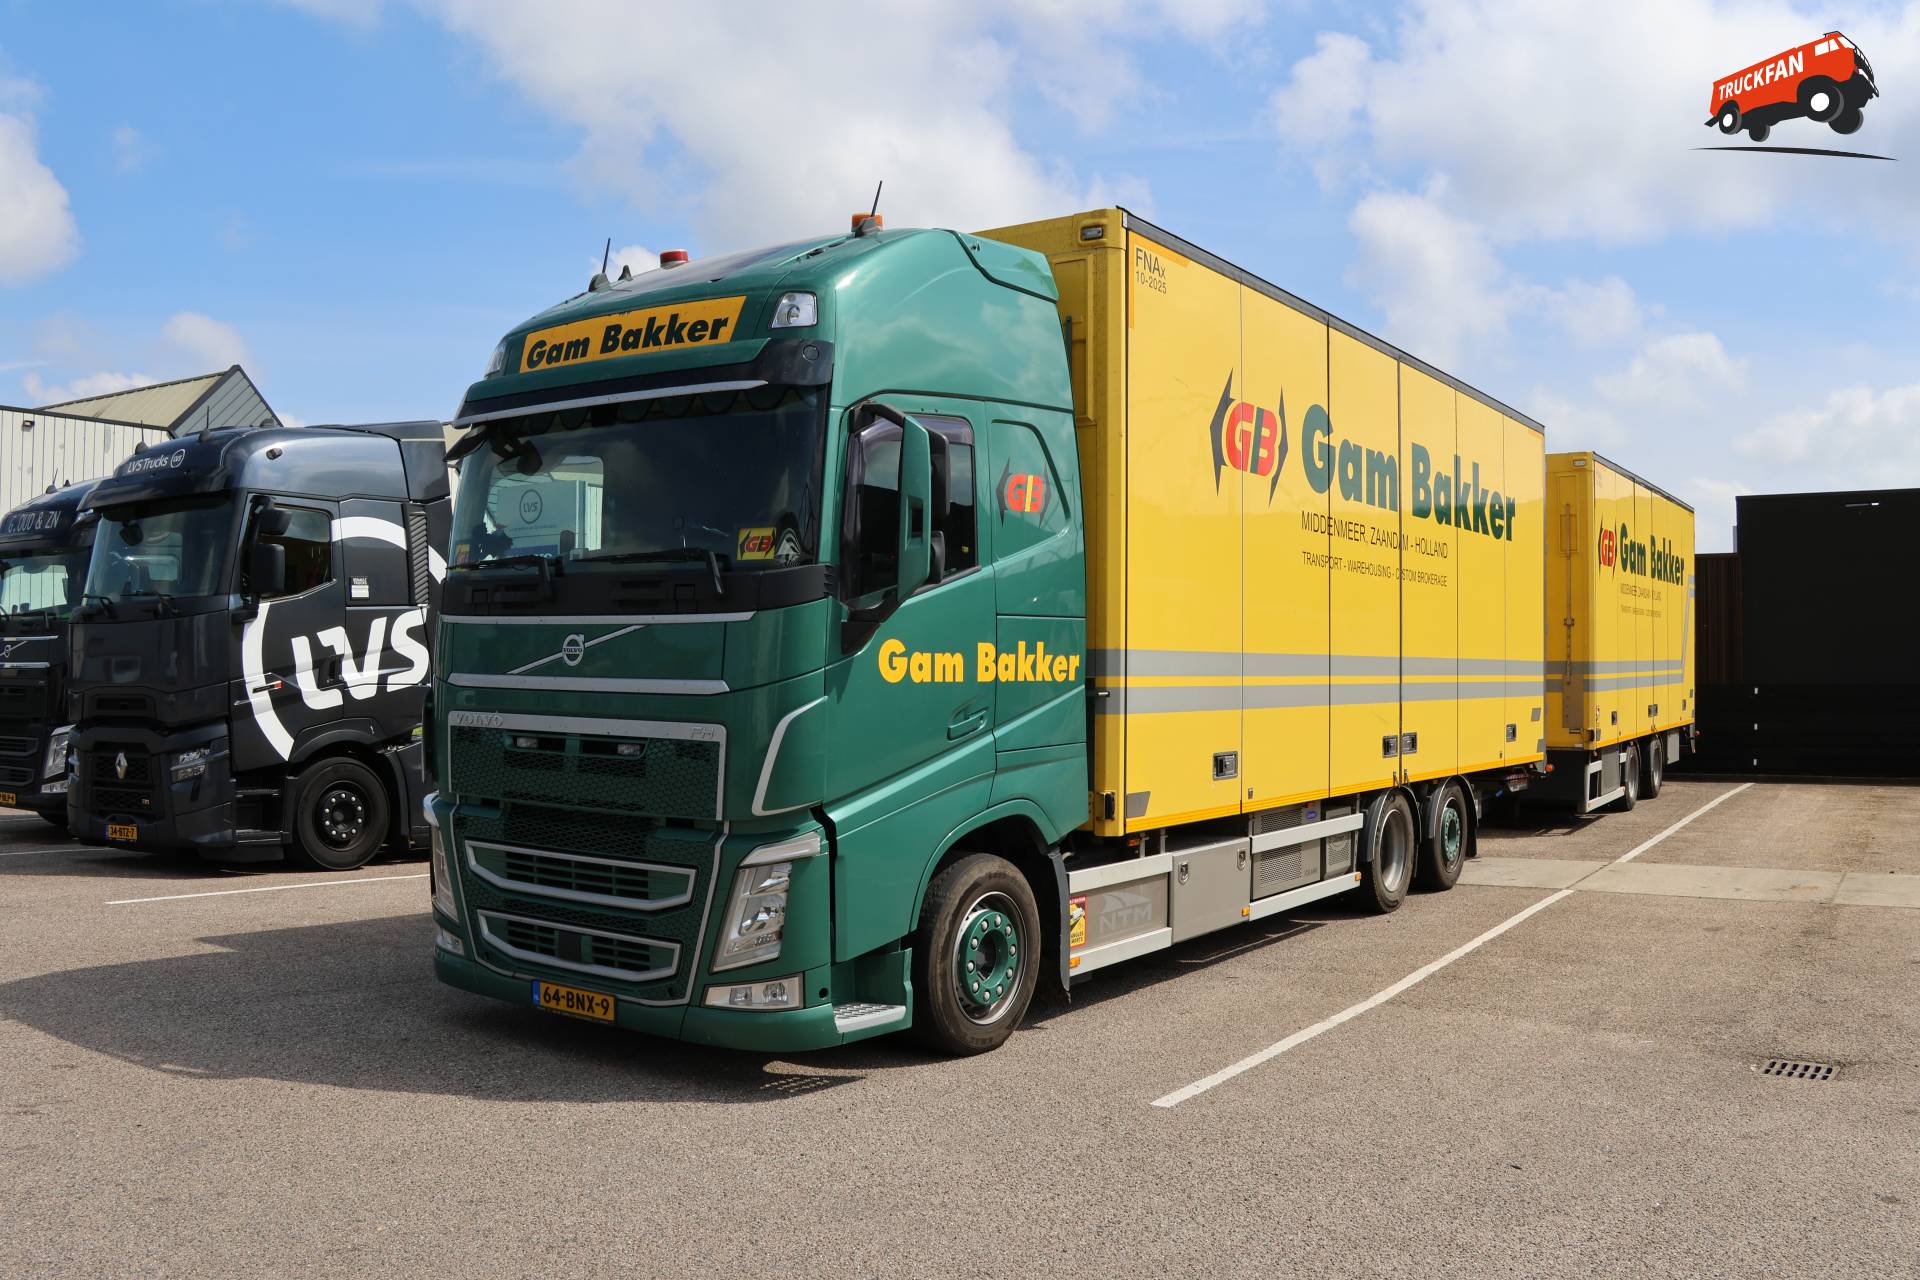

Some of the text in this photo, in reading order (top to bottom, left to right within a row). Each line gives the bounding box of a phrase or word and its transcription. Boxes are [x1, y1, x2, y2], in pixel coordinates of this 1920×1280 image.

[1136, 271, 1166, 294] 10-2025
[526, 313, 729, 370] Gam Bakker
[1225, 401, 1278, 477] GB
[127, 454, 169, 473] LVS Trucks
[1301, 403, 1516, 542] Gam Bakker
[522, 501, 539, 514] LVS
[1007, 473, 1043, 513] GB
[35, 511, 44, 530] &
[45, 510, 62, 529] ZN
[744, 535, 774, 553] GB
[1415, 536, 1448, 559] HOLLAND
[1602, 529, 1614, 567] GB
[1620, 523, 1684, 586] Gam Bakker
[1302, 551, 1343, 571] TRANSPORT
[1347, 559, 1392, 579] WAREHOUSING
[1396, 567, 1416, 582] CSTOM
[291, 607, 430, 711] LVS
[878, 638, 1080, 684] Gam Bakker
[1098, 902, 1154, 935] NTM
[543, 986, 611, 1016] 64-BNX-9
